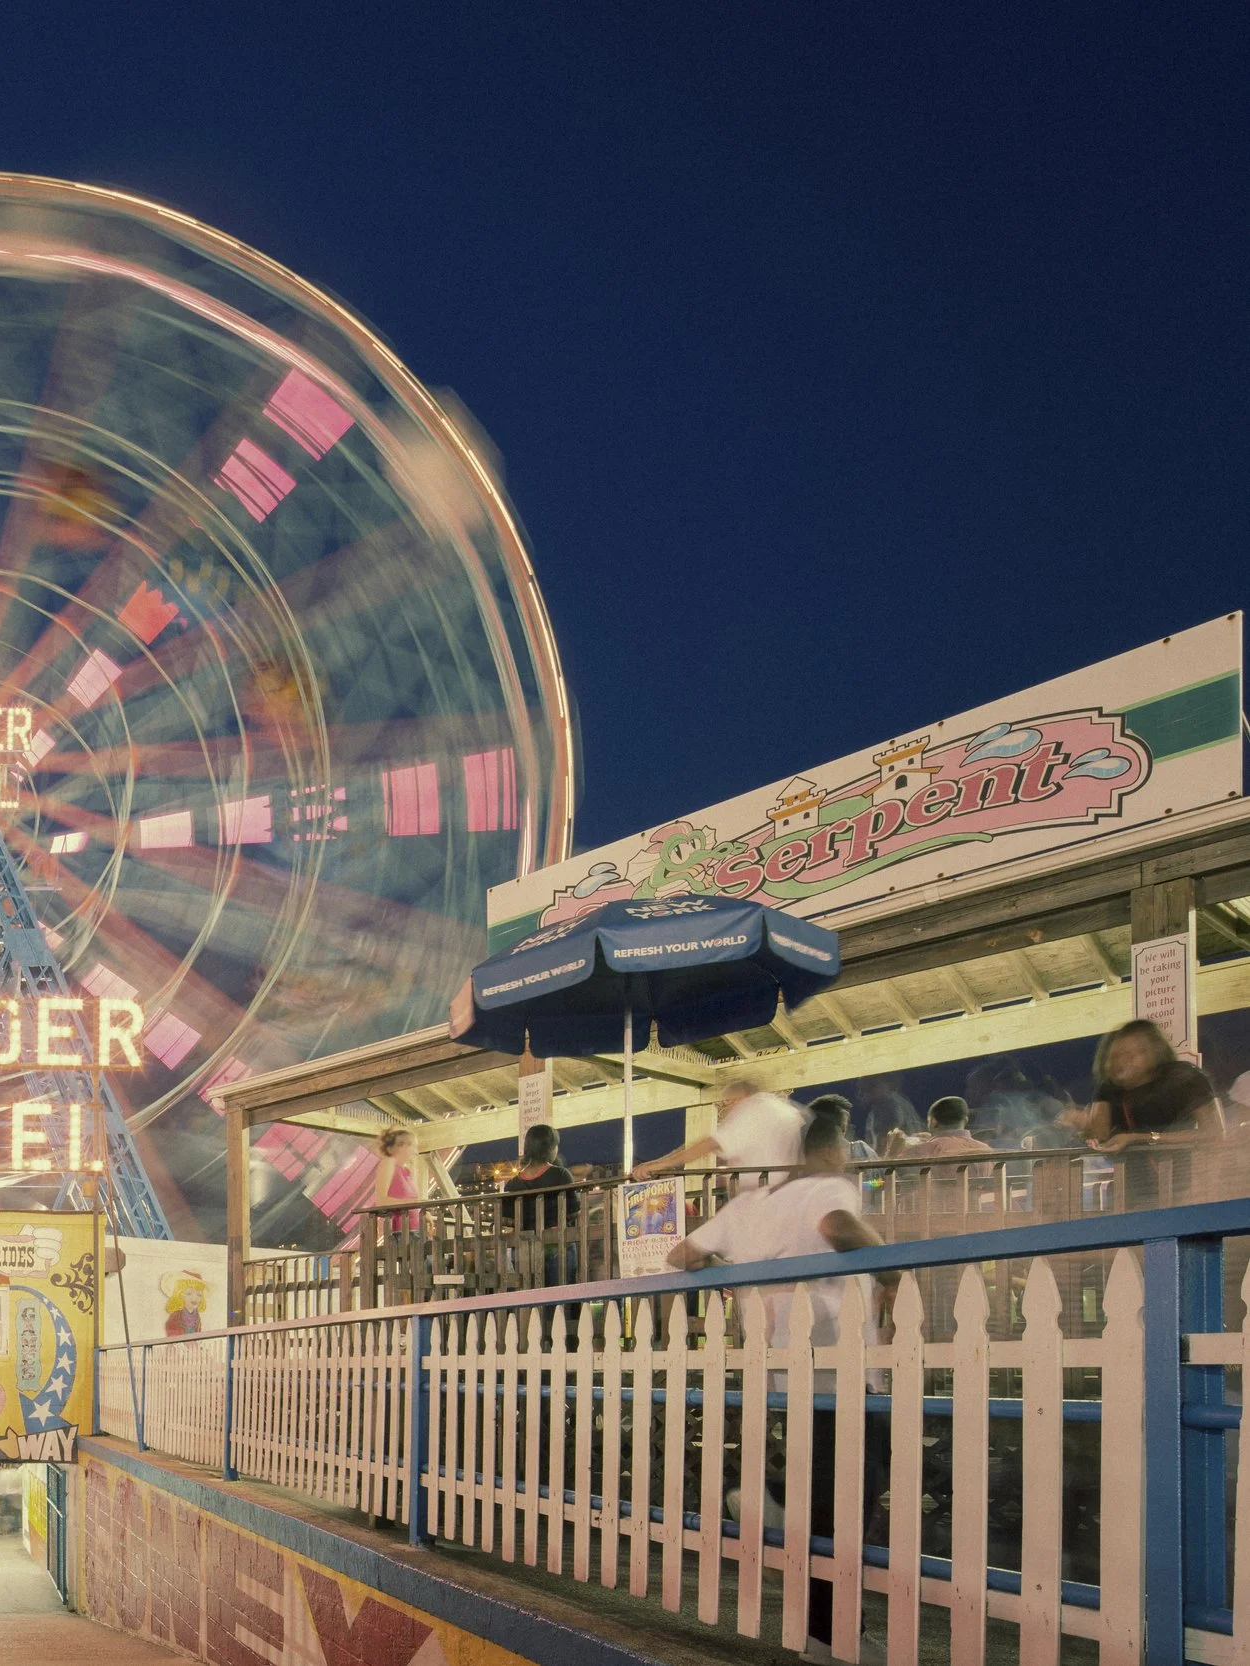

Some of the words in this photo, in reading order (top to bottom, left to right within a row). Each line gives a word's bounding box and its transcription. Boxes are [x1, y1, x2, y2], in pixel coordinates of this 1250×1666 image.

[713, 742, 1069, 899] Serpent
[625, 899, 704, 914] NEW
[634, 906, 717, 920] YORK
[613, 944, 663, 959] REFRESH
[665, 941, 699, 955] YOUR
[700, 934, 748, 950] WORLD
[1145, 953, 1157, 963] We
[1160, 948, 1176, 960] will
[1139, 966, 1151, 976] be
[1152, 960, 1182, 973] taking
[482, 979, 523, 997] REFRESH
[523, 971, 551, 985] YOUR
[1150, 974, 1170, 987] your
[1145, 985, 1177, 998] picture
[1146, 1000, 1158, 1009] on
[1160, 996, 1175, 1006] the
[624, 1181, 676, 1220] FIREWORKS
[21, 1307, 38, 1381] GAMES
[17, 1425, 78, 1462] WAY
